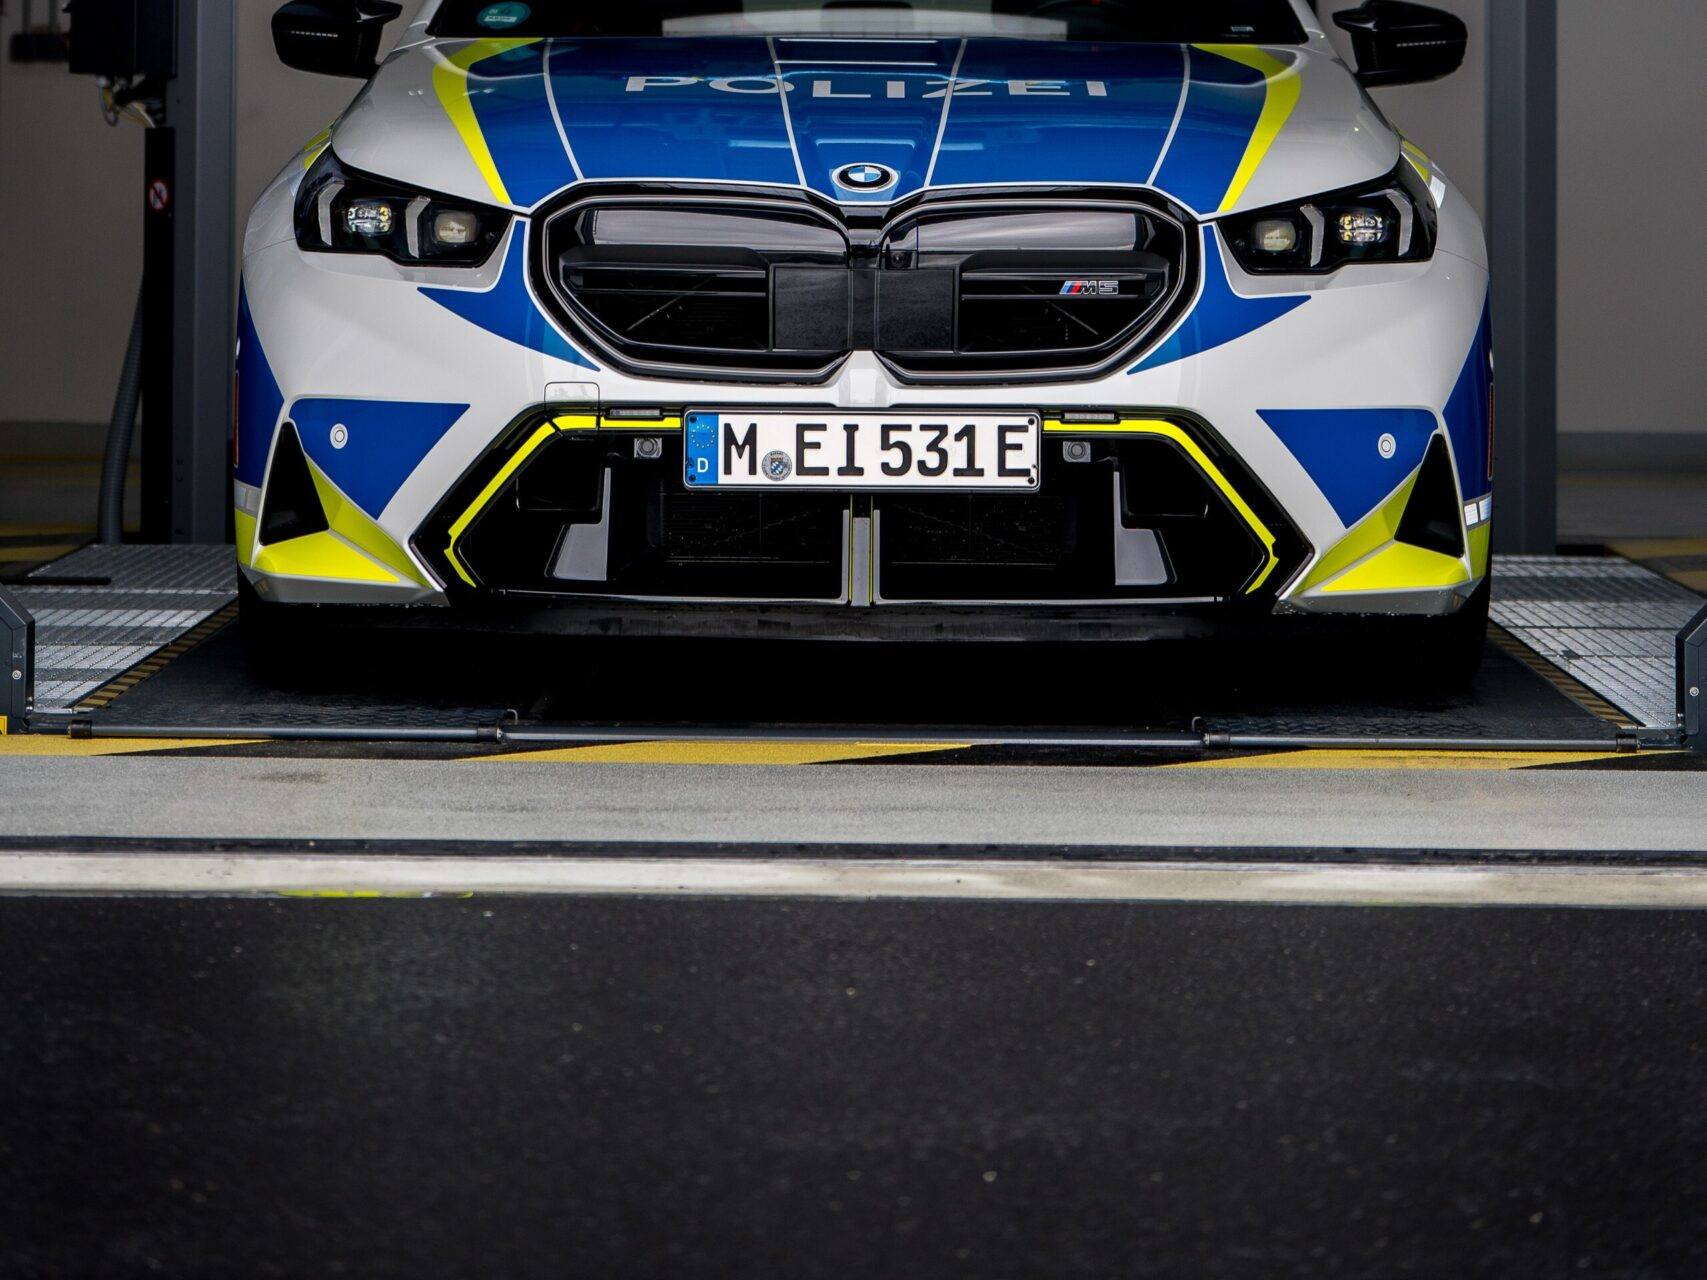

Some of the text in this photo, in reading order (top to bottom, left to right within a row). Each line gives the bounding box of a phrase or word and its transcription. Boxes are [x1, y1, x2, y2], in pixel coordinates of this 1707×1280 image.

[625, 75, 1107, 98] POLIZEI
[1076, 280, 1119, 295] M5
[697, 458, 709, 473] D
